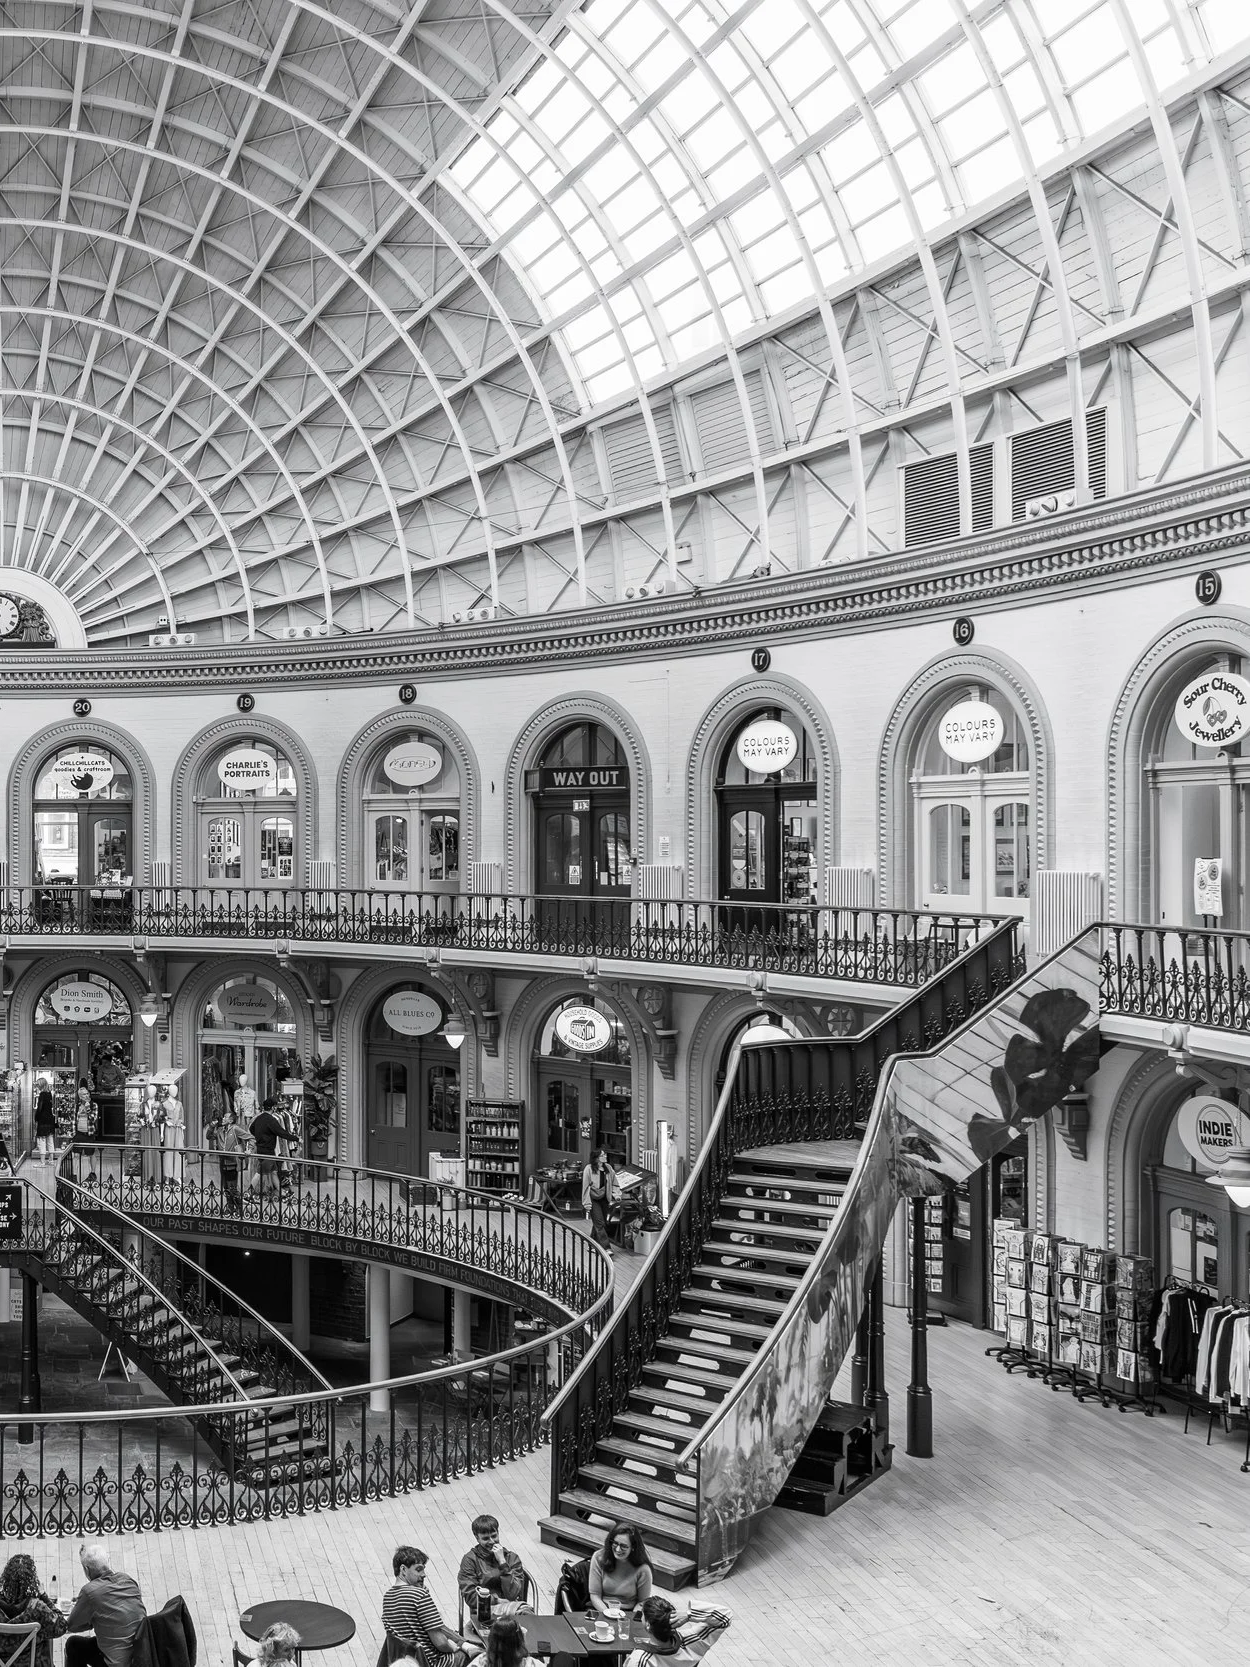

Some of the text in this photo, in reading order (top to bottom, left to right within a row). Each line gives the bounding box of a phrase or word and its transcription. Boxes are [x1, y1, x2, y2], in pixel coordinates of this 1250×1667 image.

[1198, 577, 1215, 597] 15
[955, 623, 969, 639] 16
[754, 652, 766, 666] 17
[401, 688, 413, 699] 18
[1183, 677, 1247, 709] Sour Cherry
[75, 702, 90, 713] 20
[239, 697, 251, 708] 19
[945, 719, 996, 733] COLOURS
[1189, 715, 1243, 743] Jewellery
[743, 736, 790, 747] COLOURS
[945, 731, 996, 744] MAY VARY
[743, 747, 790, 757] MAY VARY
[226, 759, 268, 769] CHARLIE'S
[224, 770, 271, 778] PORTRAITS
[552, 770, 620, 786] WAY OUT
[60, 988, 104, 999] Dion Smith
[226, 995, 268, 1008] Wardrobe
[402, 1010, 424, 1018] BLUES
[564, 1008, 603, 1023] HOUSEHOLD GOODS
[586, 1025, 595, 1040] IN
[568, 1039, 584, 1049] VINTAGE
[585, 1038, 603, 1049] SUPPLIES
[1199, 1119, 1233, 1137] INDIE
[1200, 1135, 1234, 1147] MAKERS
[142, 1216, 165, 1228] OUR
[168, 1219, 195, 1231] PAST
[198, 1222, 239, 1235] SHAPES
[242, 1226, 263, 1239] OUR
[266, 1229, 305, 1244] FUTURE
[310, 1235, 342, 1250] BLOCK
[345, 1241, 358, 1253] BY
[361, 1244, 390, 1260] BLOCK
[393, 1251, 409, 1264] WE
[411, 1255, 436, 1271] BUILD
[438, 1262, 458, 1278] FIRM
[460, 1269, 510, 1297] FOUNDATIONS
